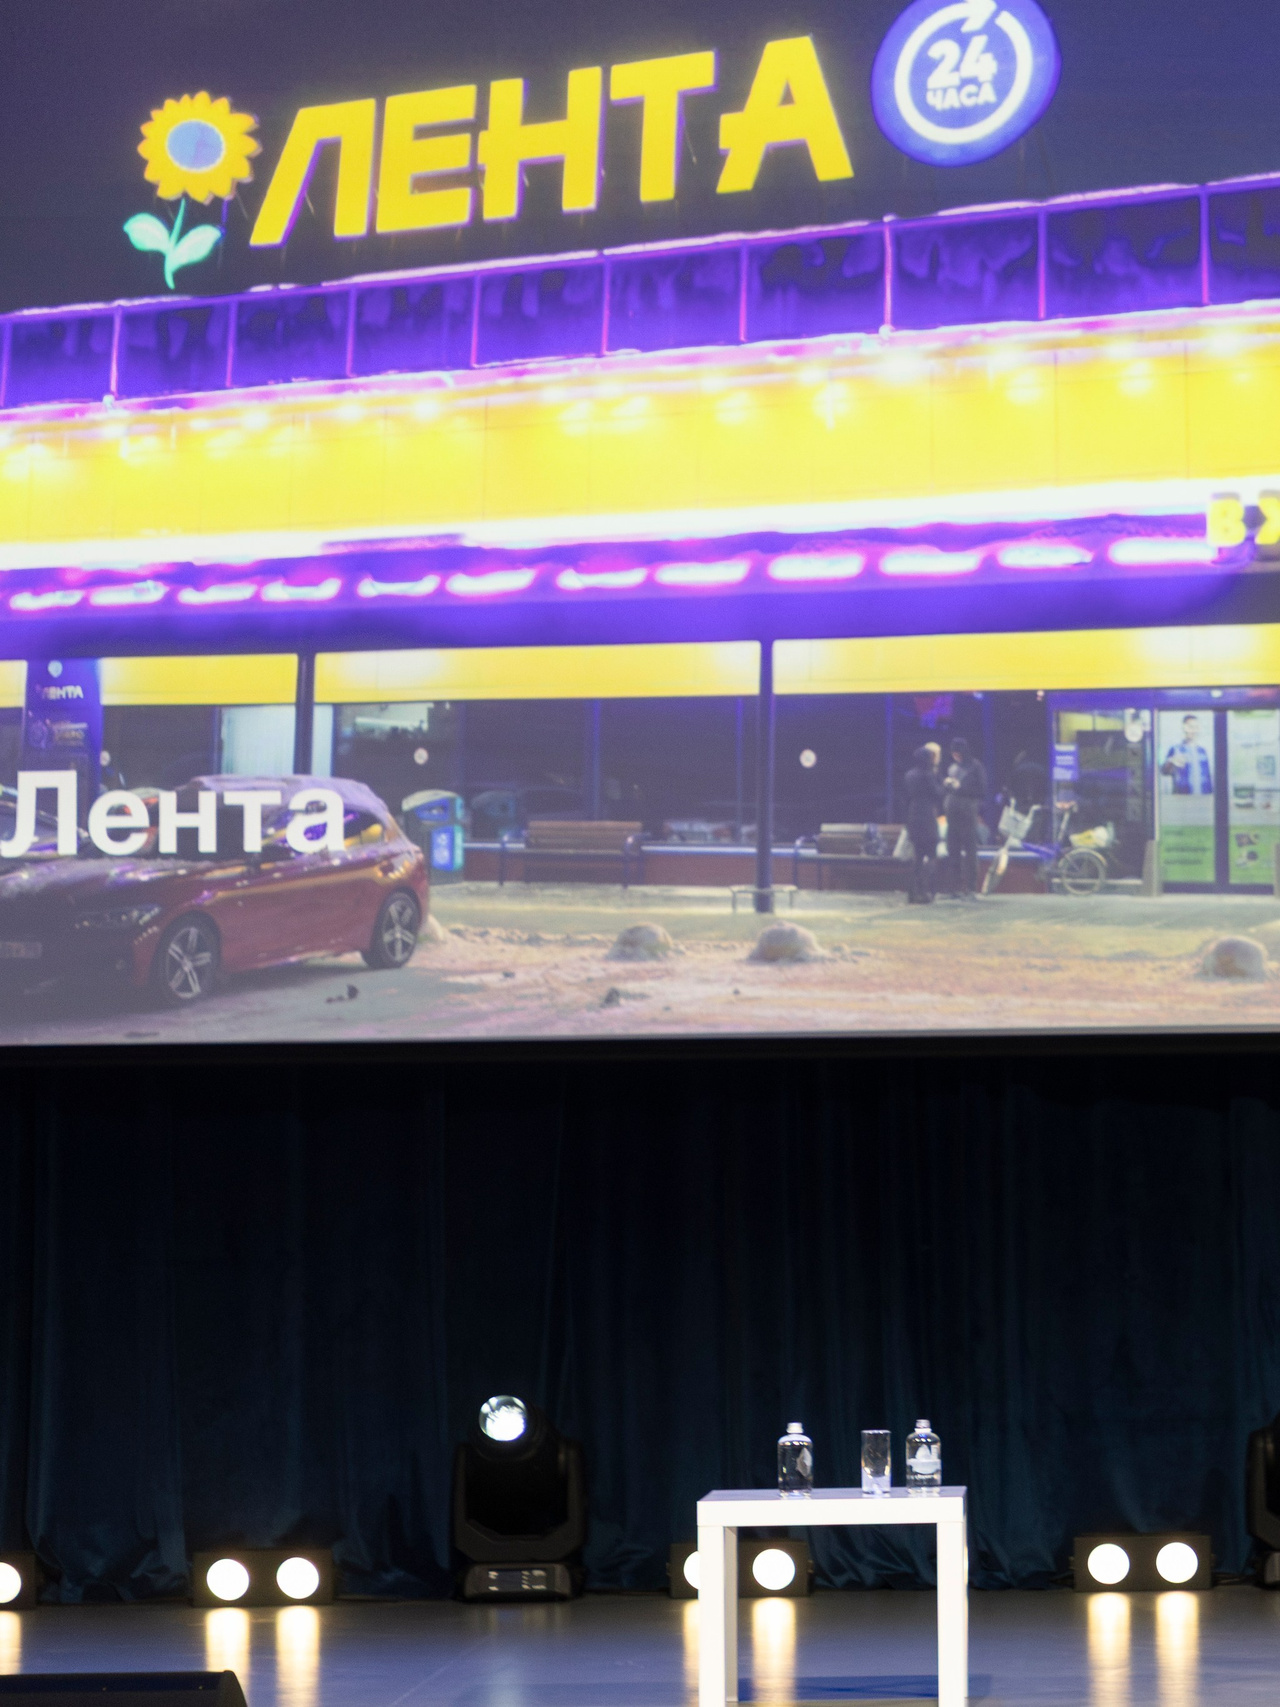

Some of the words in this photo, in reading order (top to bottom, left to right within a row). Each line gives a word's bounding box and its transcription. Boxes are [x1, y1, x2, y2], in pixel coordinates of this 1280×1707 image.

[925, 80, 998, 112] ЧАСА
[926, 34, 998, 90] 24
[249, 34, 854, 247] ЛЕНТА
[0, 769, 347, 858] Лента
